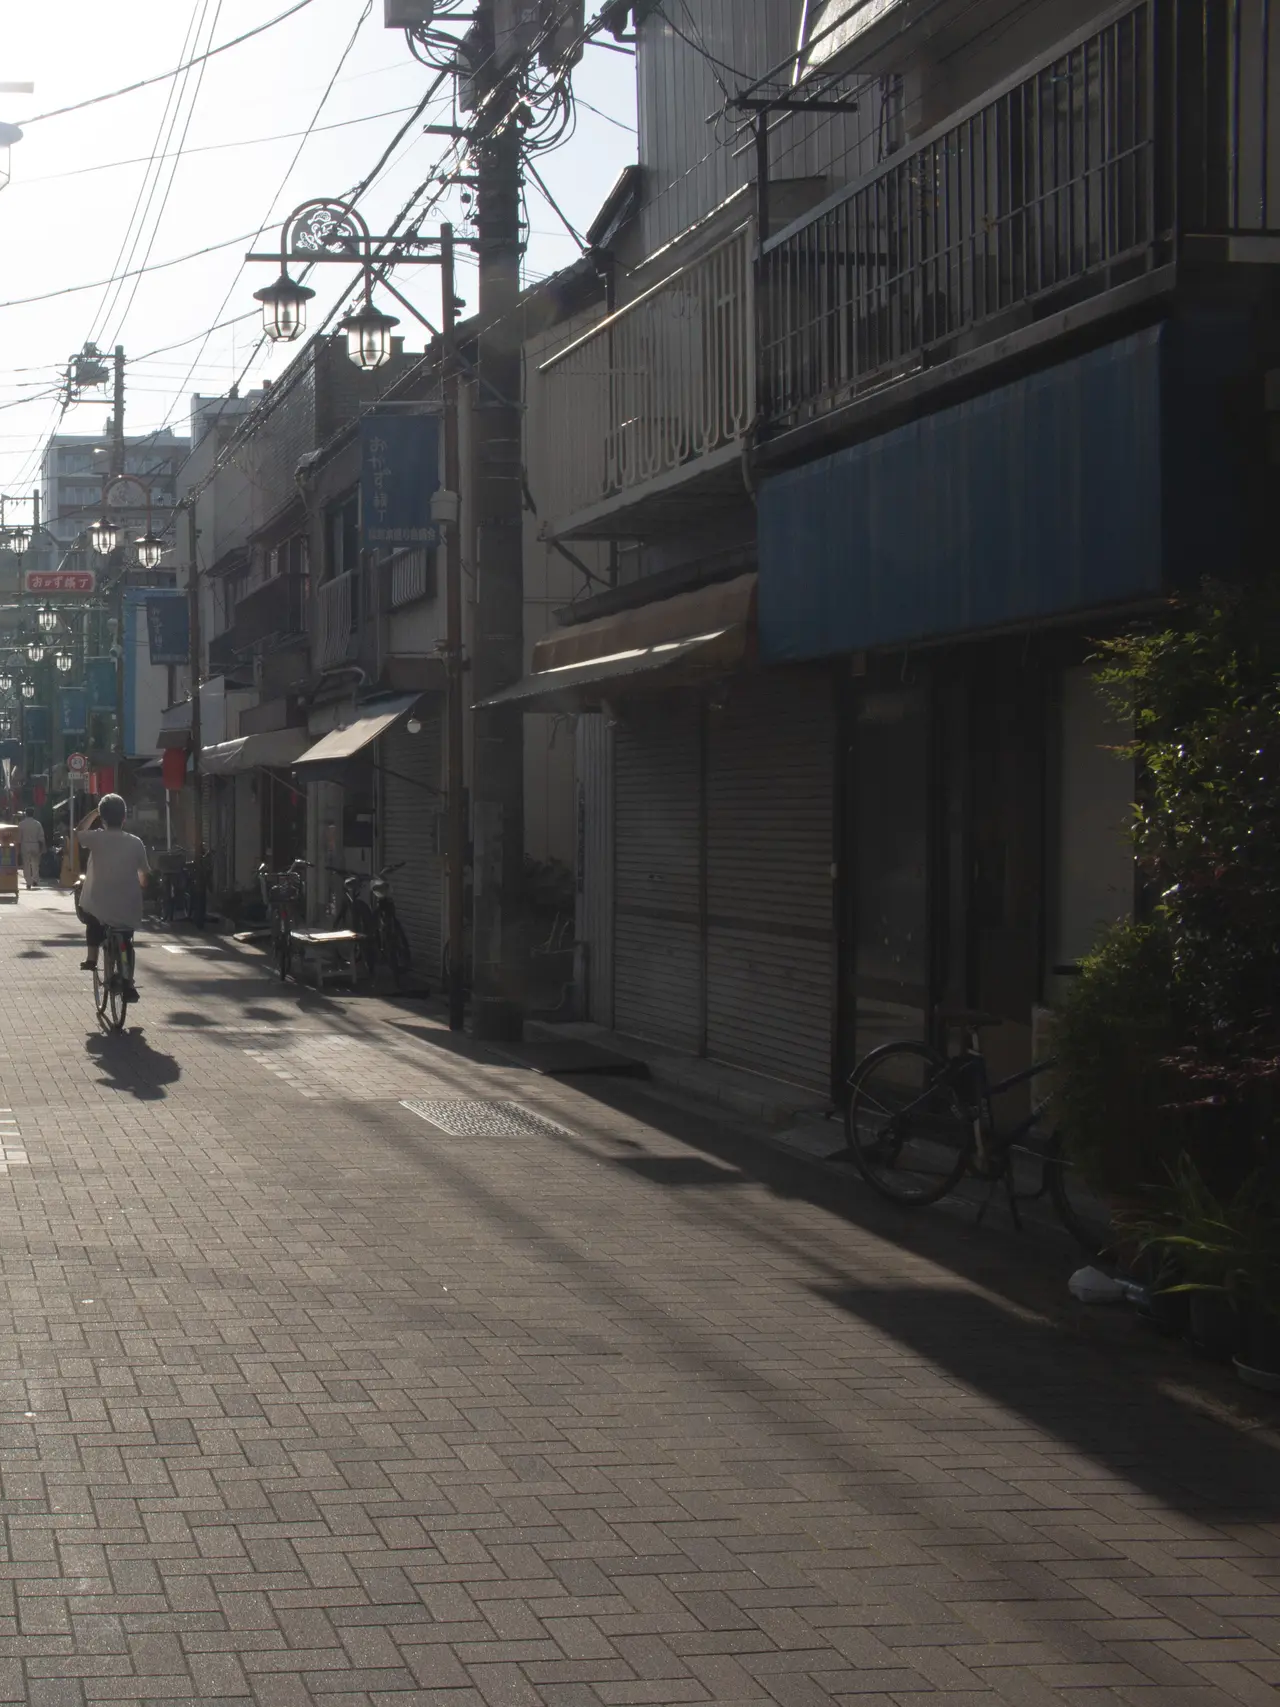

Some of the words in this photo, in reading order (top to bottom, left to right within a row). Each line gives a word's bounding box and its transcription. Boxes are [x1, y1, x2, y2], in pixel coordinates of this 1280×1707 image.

[366, 436, 392, 523] おかず横丁
[32, 575, 89, 589] おかず横丁
